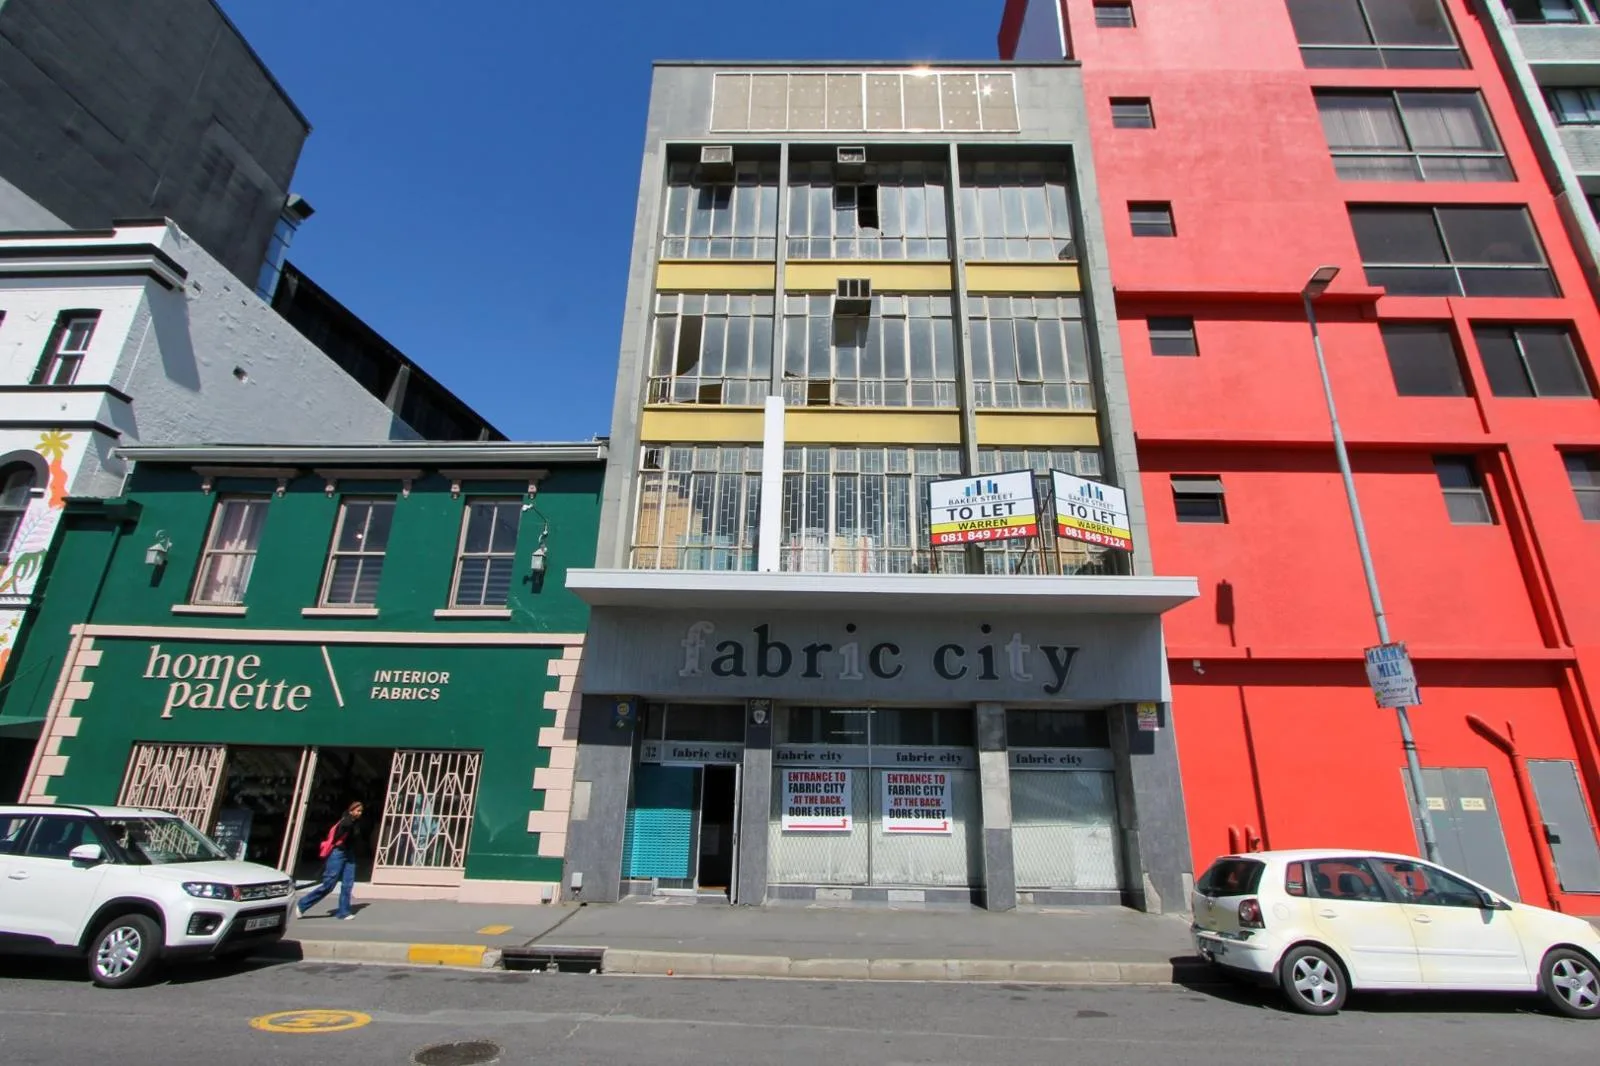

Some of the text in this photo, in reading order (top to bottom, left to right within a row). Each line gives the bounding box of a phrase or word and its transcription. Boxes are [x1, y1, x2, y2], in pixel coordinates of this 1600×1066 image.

[948, 492, 1014, 506] BAKER STREET
[1068, 493, 1116, 510] BAKER STREET
[946, 502, 1014, 521] TO LET
[1067, 503, 1117, 526] TO LET
[958, 519, 1008, 531] WARREN
[1076, 519, 1113, 535] WARREN
[941, 526, 1027, 543] 081 849 7124
[1065, 526, 1126, 548] 081 849 7124
[142, 644, 261, 681] home
[679, 621, 1080, 695] fabric city
[373, 670, 450, 685] INTERIOR
[160, 678, 312, 719] palette
[370, 687, 441, 701] FABRICS
[672, 746, 738, 761] fabric city
[776, 749, 843, 763] fabric city
[896, 751, 963, 765] fabric city
[1015, 753, 1083, 766] fabric city
[787, 771, 846, 783] ENTRANCE TO
[887, 773, 946, 785] ENTRANCE TO
[788, 783, 845, 794] FABRIC CITY
[888, 785, 945, 796] FABRIC CITY
[793, 795, 841, 805] AT THE BACK
[893, 798, 941, 807] AT THE BACK
[788, 806, 846, 818] DORE STREET
[888, 808, 947, 820] DORE STREET
